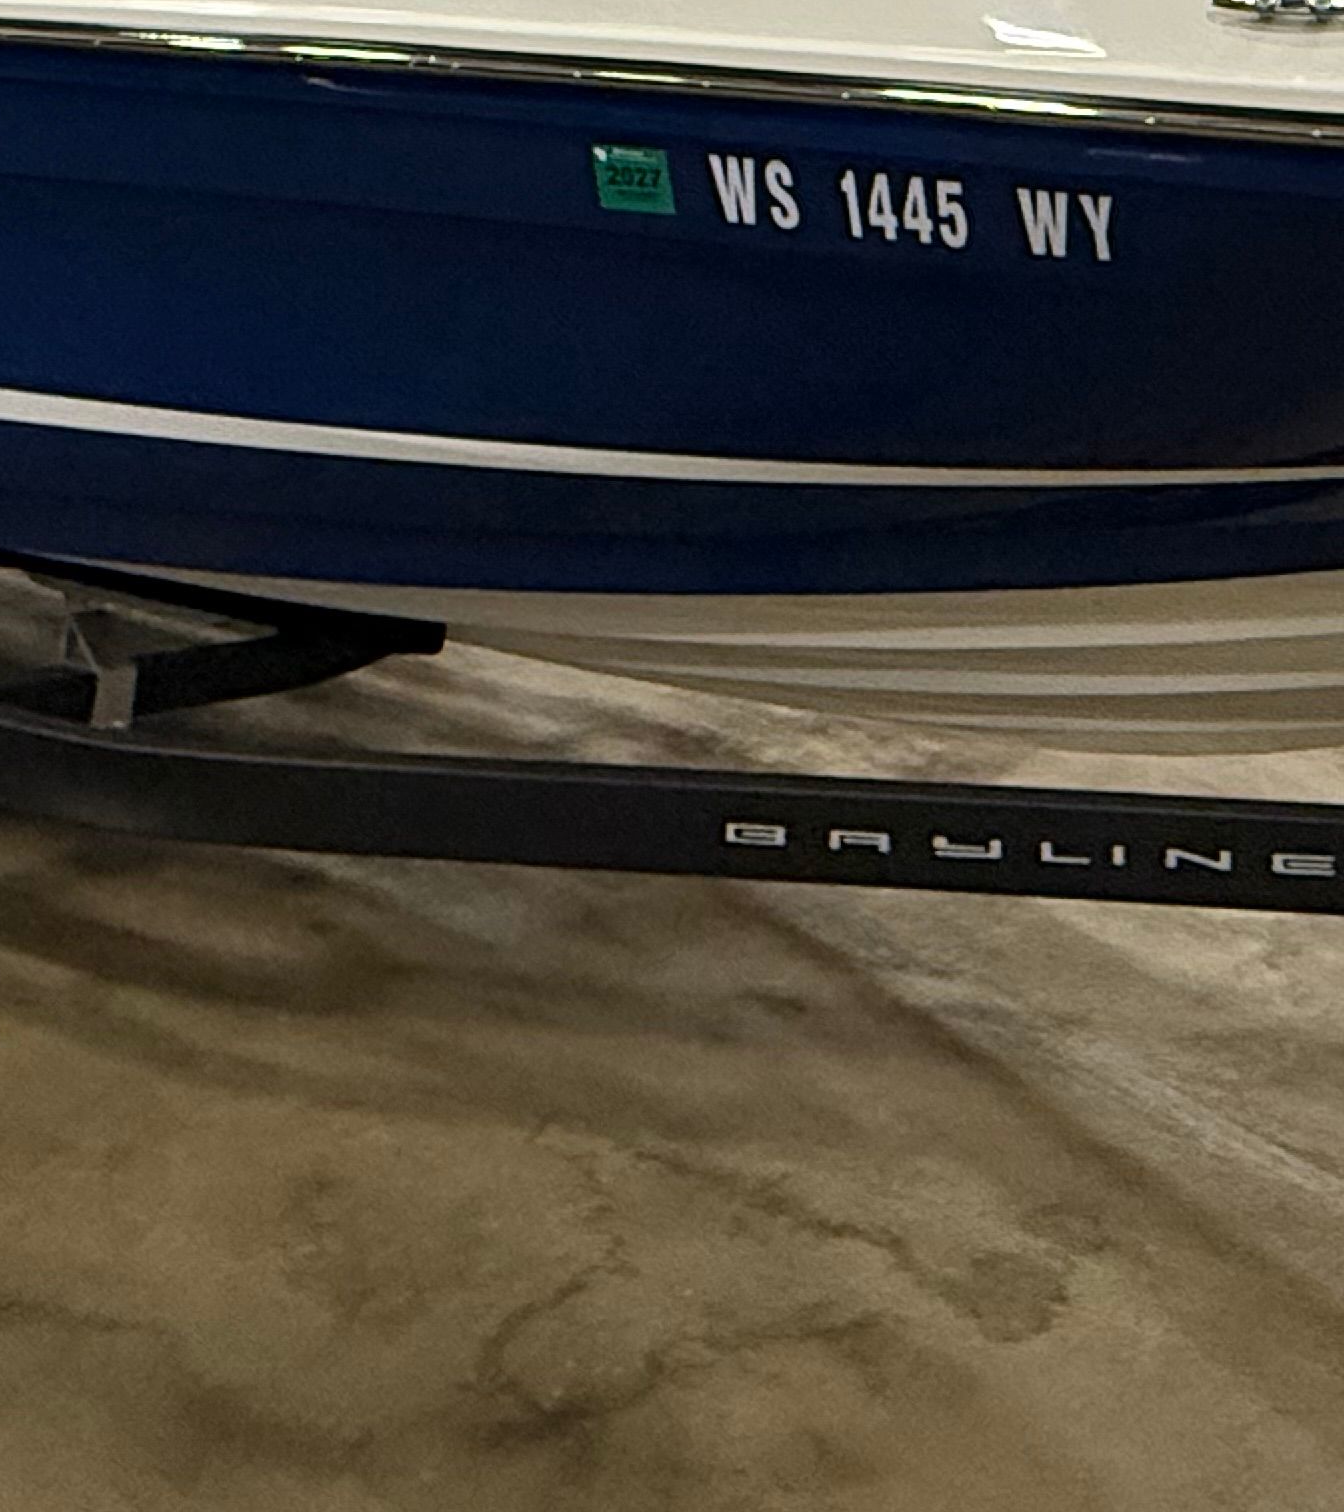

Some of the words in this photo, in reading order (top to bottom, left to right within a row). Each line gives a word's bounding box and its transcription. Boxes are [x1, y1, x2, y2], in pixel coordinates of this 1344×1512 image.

[604, 164, 663, 188] 2027
[708, 152, 801, 230] WS
[840, 168, 969, 249] 1445
[1016, 186, 1113, 262] WY
